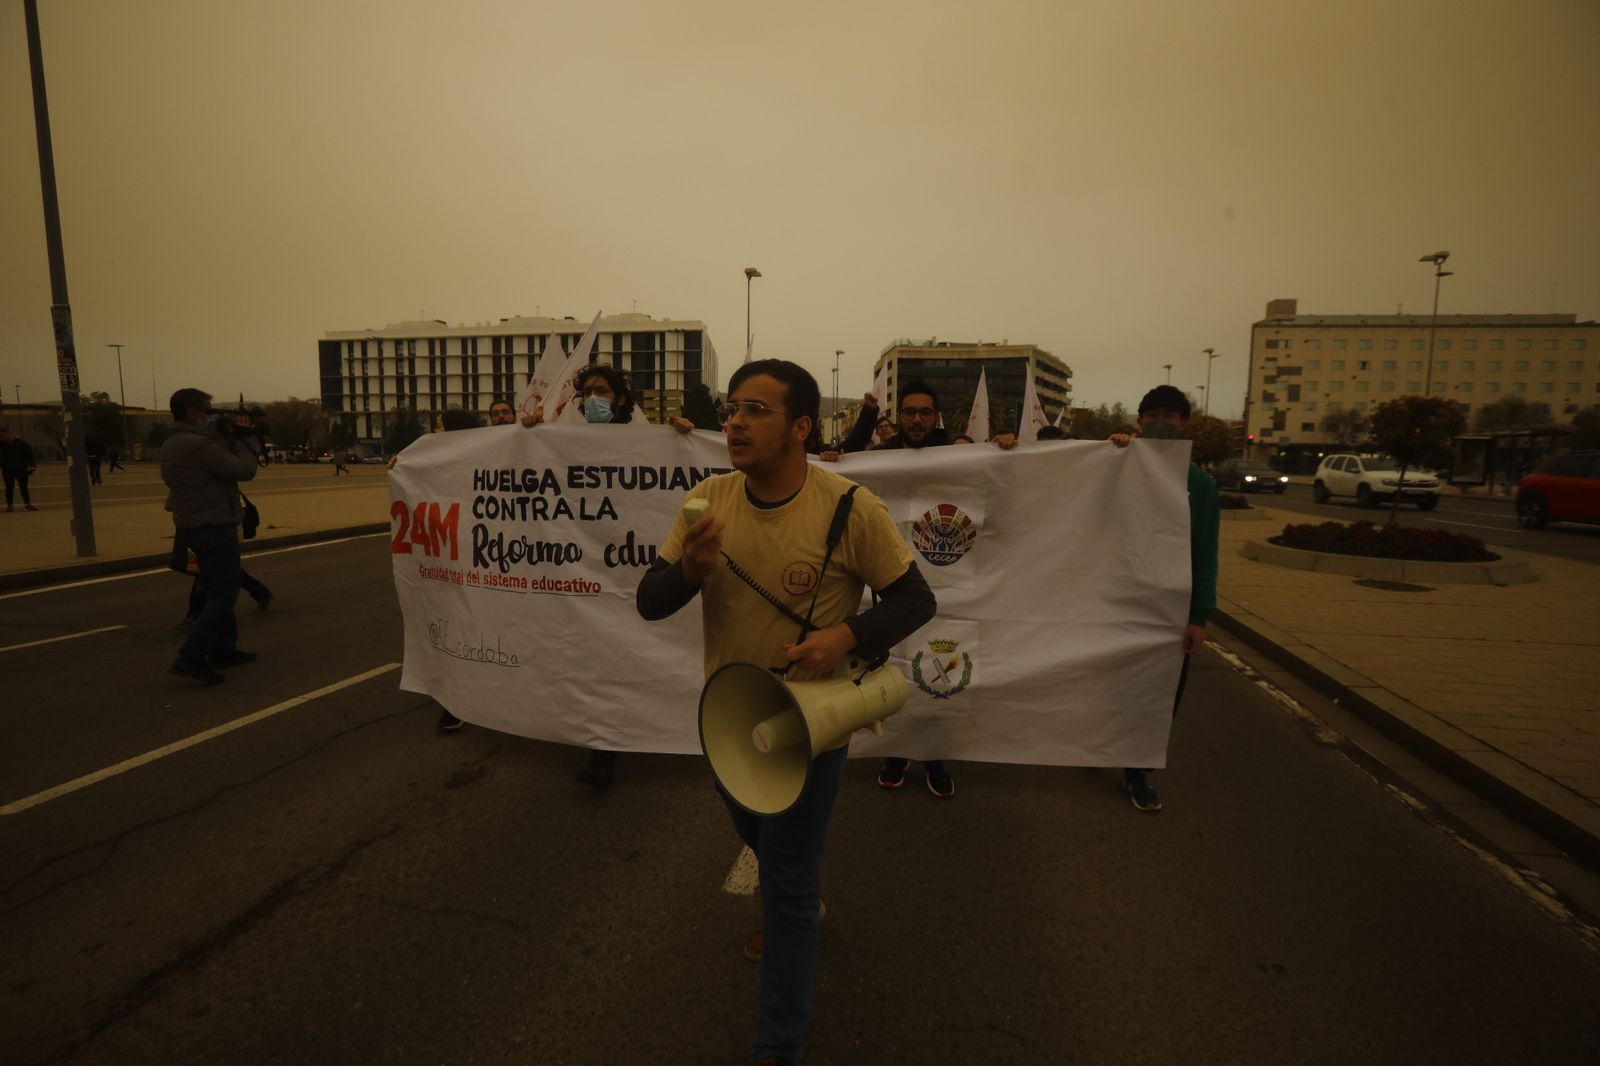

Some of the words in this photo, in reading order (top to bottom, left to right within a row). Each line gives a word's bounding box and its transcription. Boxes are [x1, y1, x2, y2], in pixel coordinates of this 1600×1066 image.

[473, 468, 561, 496] HUELGA
[567, 466, 736, 491] ESTUDIANT
[472, 495, 574, 522] CONTRA
[580, 496, 618, 521] LA
[390, 500, 460, 561] 24M
[472, 523, 582, 574] Reforma
[604, 530, 656, 568] edu
[466, 569, 480, 585] del
[483, 571, 527, 589] sistema
[532, 576, 601, 594] educativo
